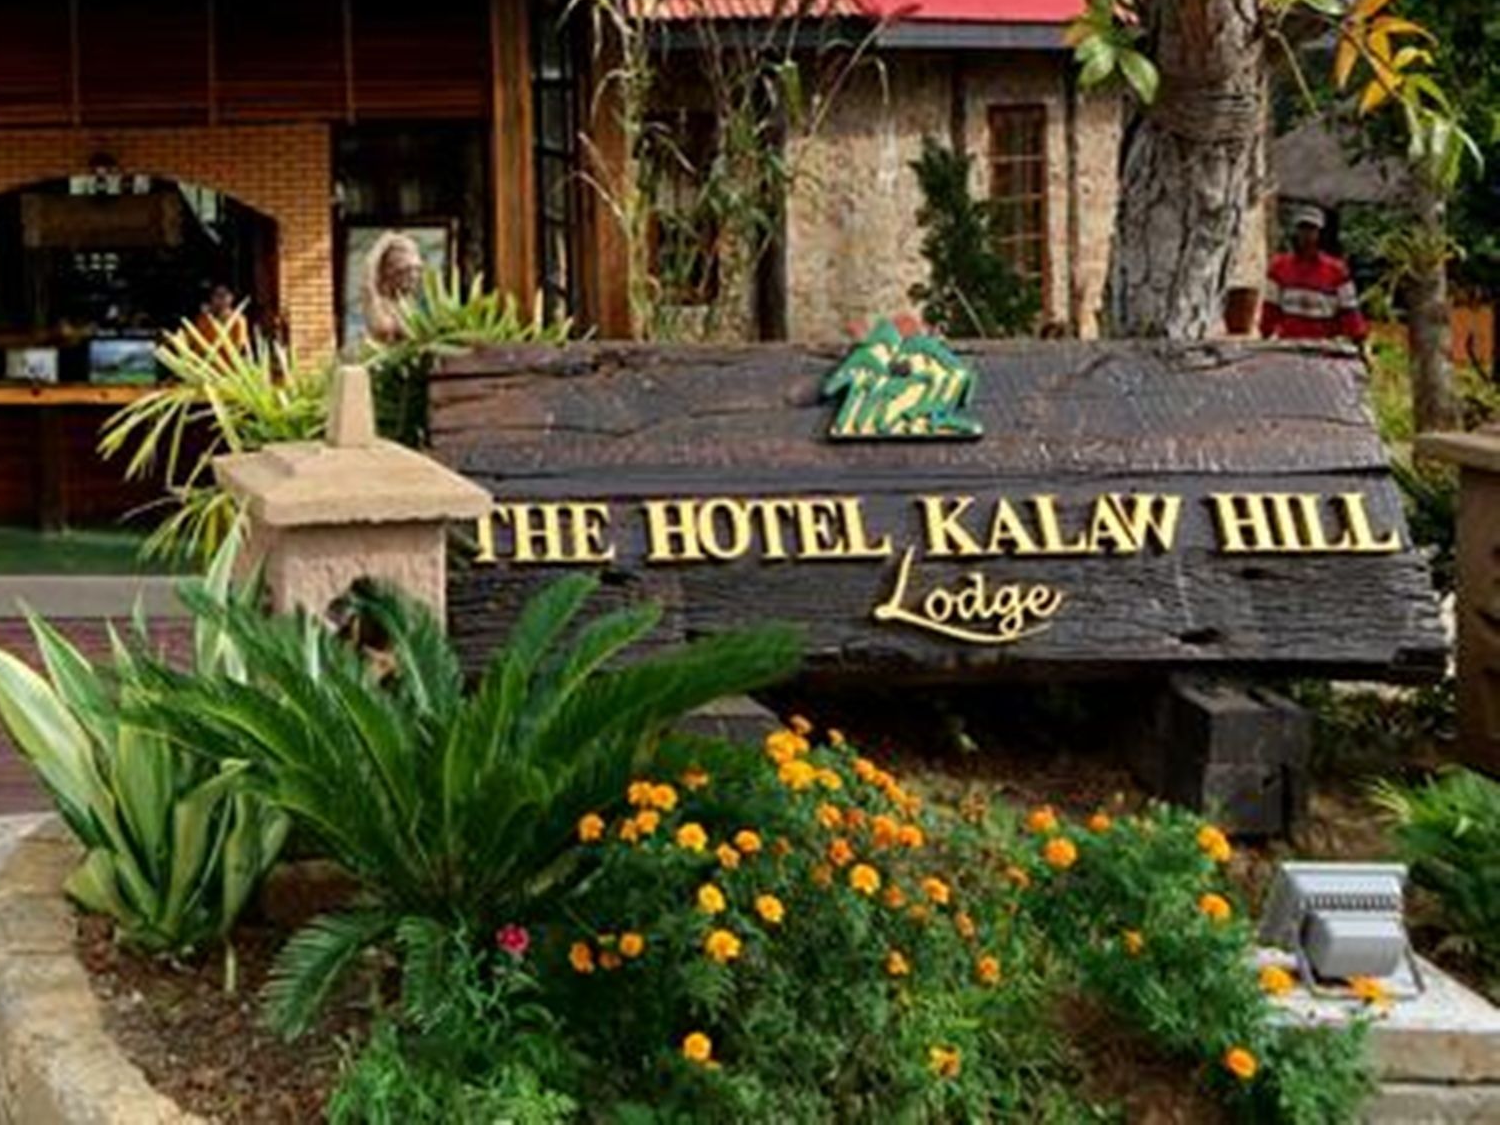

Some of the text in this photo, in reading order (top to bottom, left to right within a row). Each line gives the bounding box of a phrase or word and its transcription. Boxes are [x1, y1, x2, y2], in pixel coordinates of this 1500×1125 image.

[473, 491, 1402, 563] THE HOTEL KALAW HILL
[874, 545, 1065, 643] Lodge
